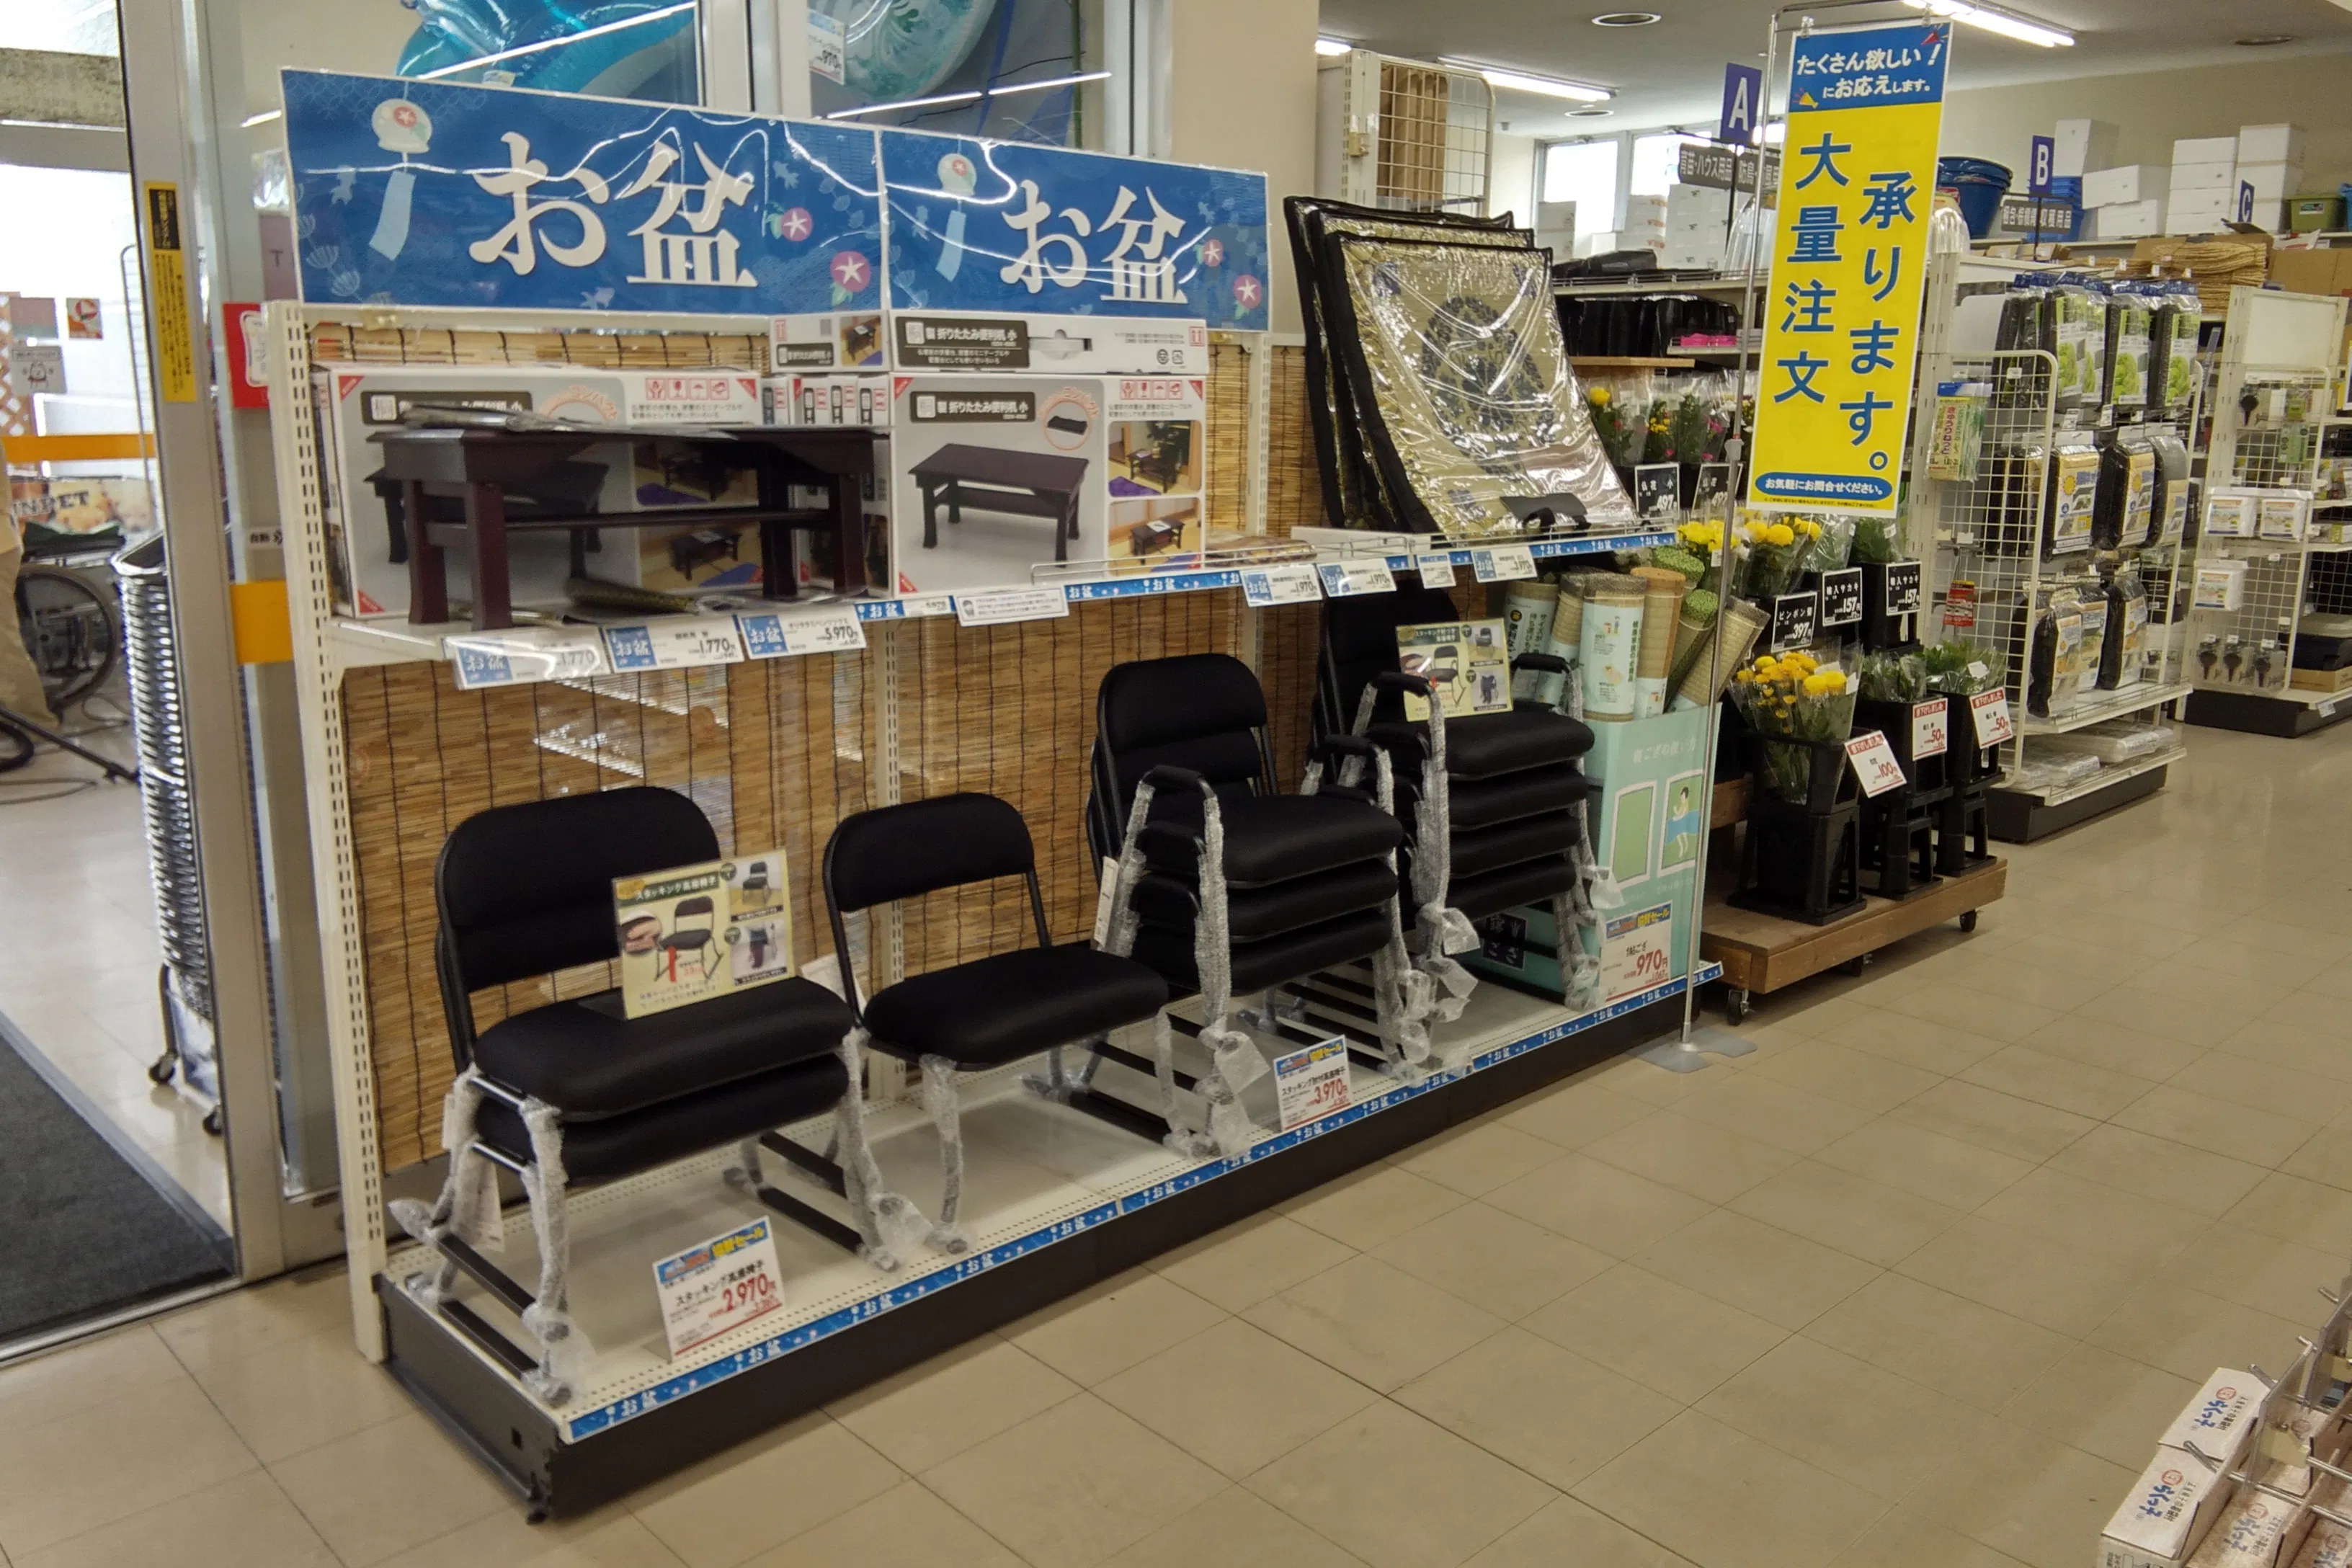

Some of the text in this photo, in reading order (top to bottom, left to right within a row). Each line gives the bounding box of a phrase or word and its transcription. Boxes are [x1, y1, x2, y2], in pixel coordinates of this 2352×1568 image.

[1822, 74, 1931, 99] にお応えします。
[1728, 77, 1749, 131] A
[2036, 144, 2049, 186] B
[469, 131, 759, 288] お盆
[2241, 187, 2251, 221] C
[999, 180, 1189, 304] お盆
[1773, 133, 1852, 404] 大量注文
[1839, 172, 1918, 471] 承ります。
[1765, 478, 1883, 496] お気軽にお問合せください。
[1069, 585, 1092, 599] お盆
[1153, 577, 1175, 591] お盆
[1247, 580, 1268, 594] お盆
[870, 603, 898, 618] お盆
[750, 626, 783, 643] お盆
[616, 639, 651, 657] お盆
[467, 654, 505, 672] お盆
[1494, 1048, 1510, 1061] お盆
[1370, 1095, 1389, 1111] お盆
[1304, 1122, 1324, 1139] お盆
[1152, 1181, 1176, 1200] お盆
[1061, 1216, 1086, 1236] お盆
[966, 1252, 994, 1274] お盆
[864, 1293, 894, 1317] お盆
[748, 1339, 781, 1365] お盆
[622, 1390, 656, 1417] お盆
